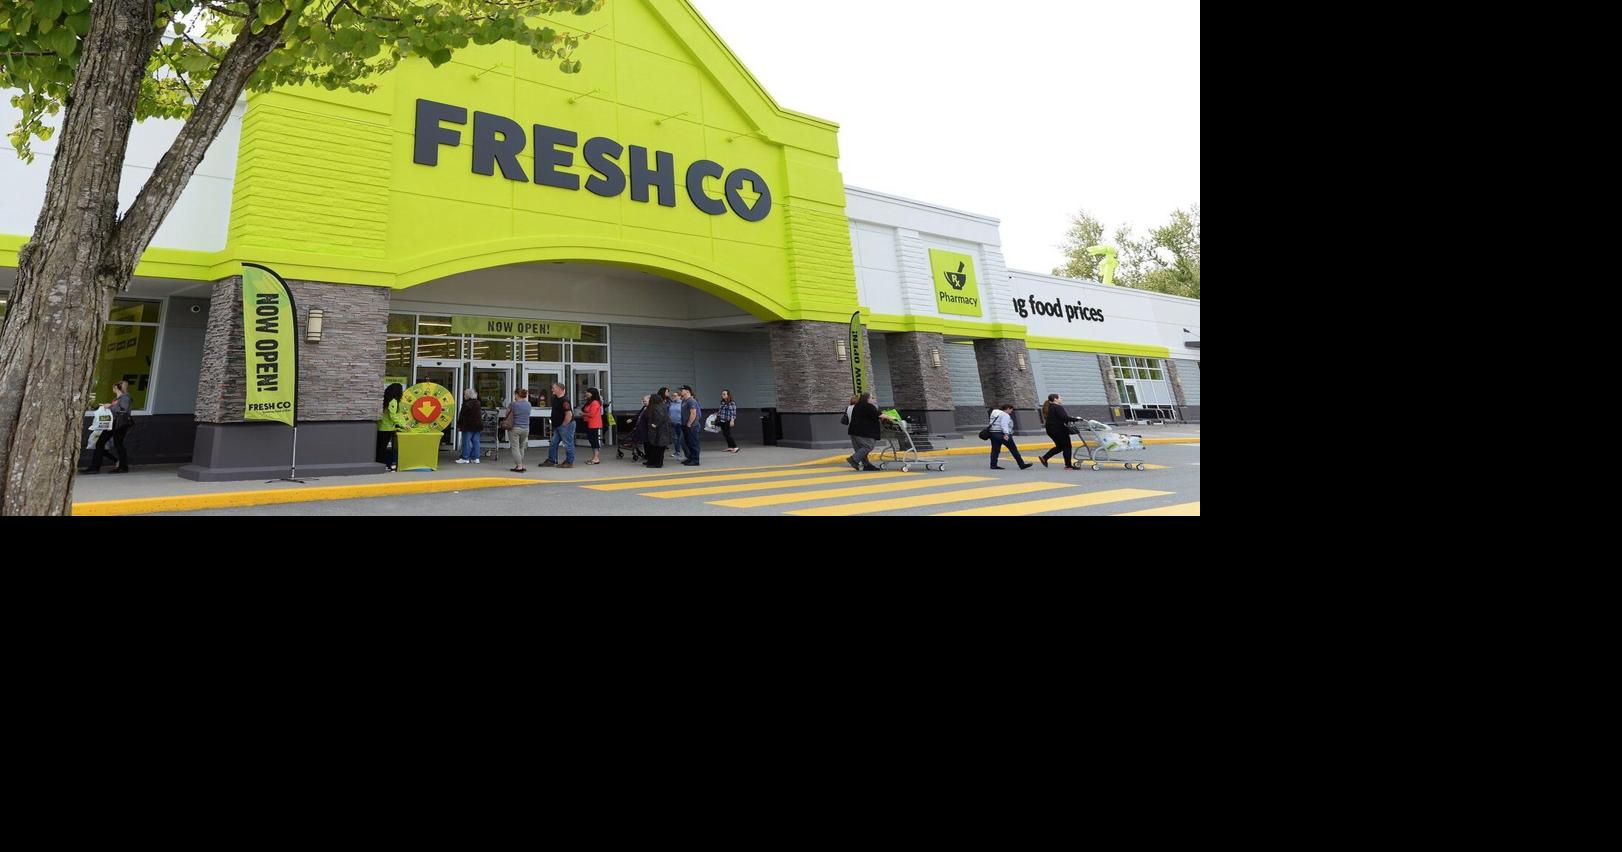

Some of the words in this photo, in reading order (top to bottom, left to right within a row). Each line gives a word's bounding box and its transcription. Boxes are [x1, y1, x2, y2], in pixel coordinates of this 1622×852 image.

[413, 98, 676, 208] FRESH
[686, 159, 773, 222] CO
[255, 293, 279, 334] NOW
[939, 291, 978, 308] Pharmacy
[1029, 294, 1063, 318] food
[1065, 301, 1105, 323] prices
[487, 320, 513, 333] NOW
[517, 322, 551, 335] OPEN!
[852, 331, 860, 364] OPEN!
[255, 339, 279, 392] OPEN!
[854, 367, 862, 394] NOW
[248, 402, 275, 411] FRESH
[276, 401, 291, 409] CO
